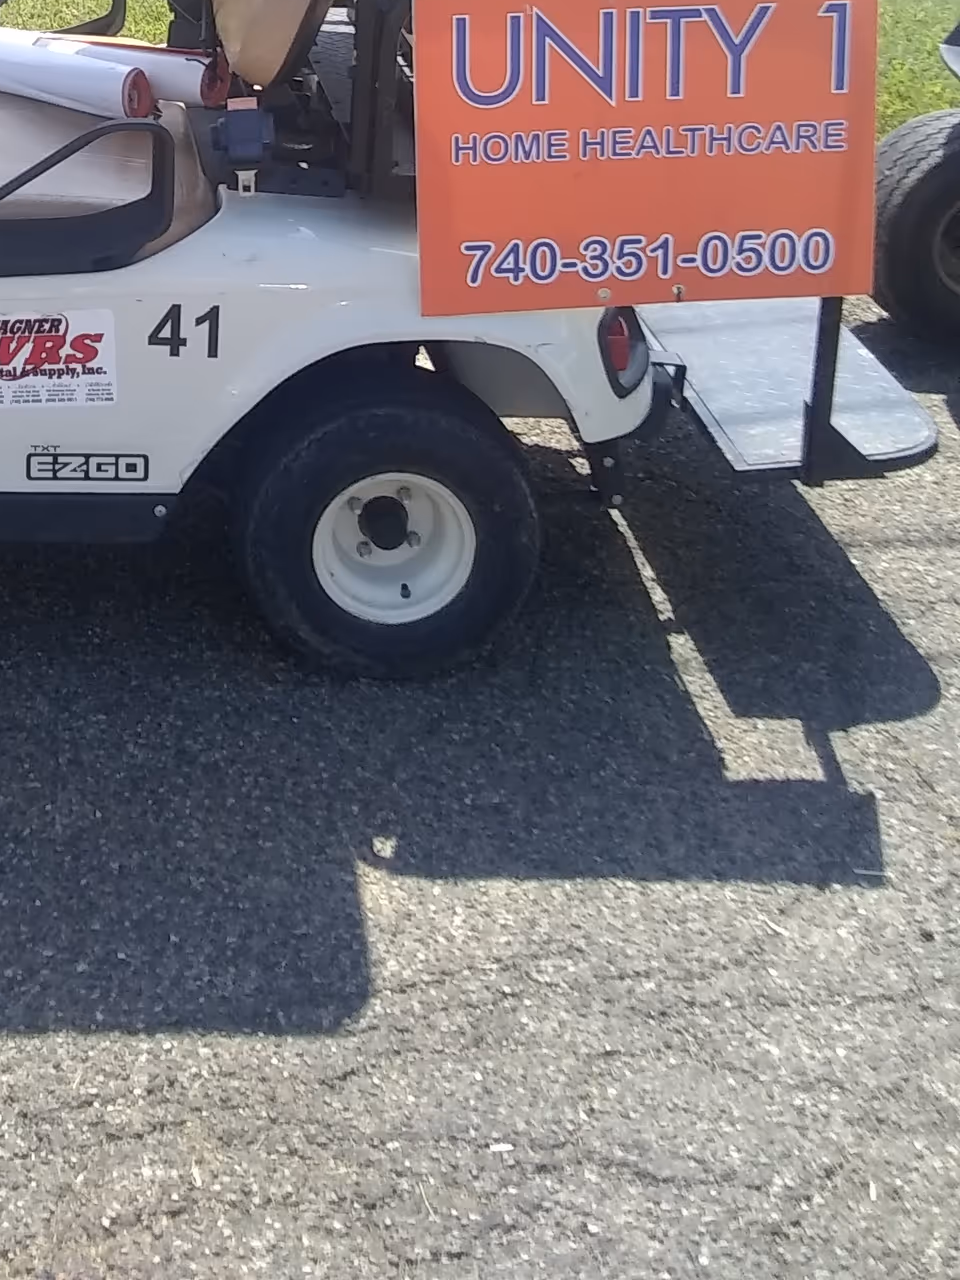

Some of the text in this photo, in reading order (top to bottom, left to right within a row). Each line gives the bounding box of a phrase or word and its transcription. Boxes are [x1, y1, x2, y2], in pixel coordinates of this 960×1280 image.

[451, 0, 852, 109] UNITY 1
[451, 119, 848, 166] HOME HEALTHCARE
[460, 228, 835, 287] 740-351-0500
[147, 303, 221, 358] 41
[81, 364, 107, 375] Inc.
[30, 444, 61, 453] TXT
